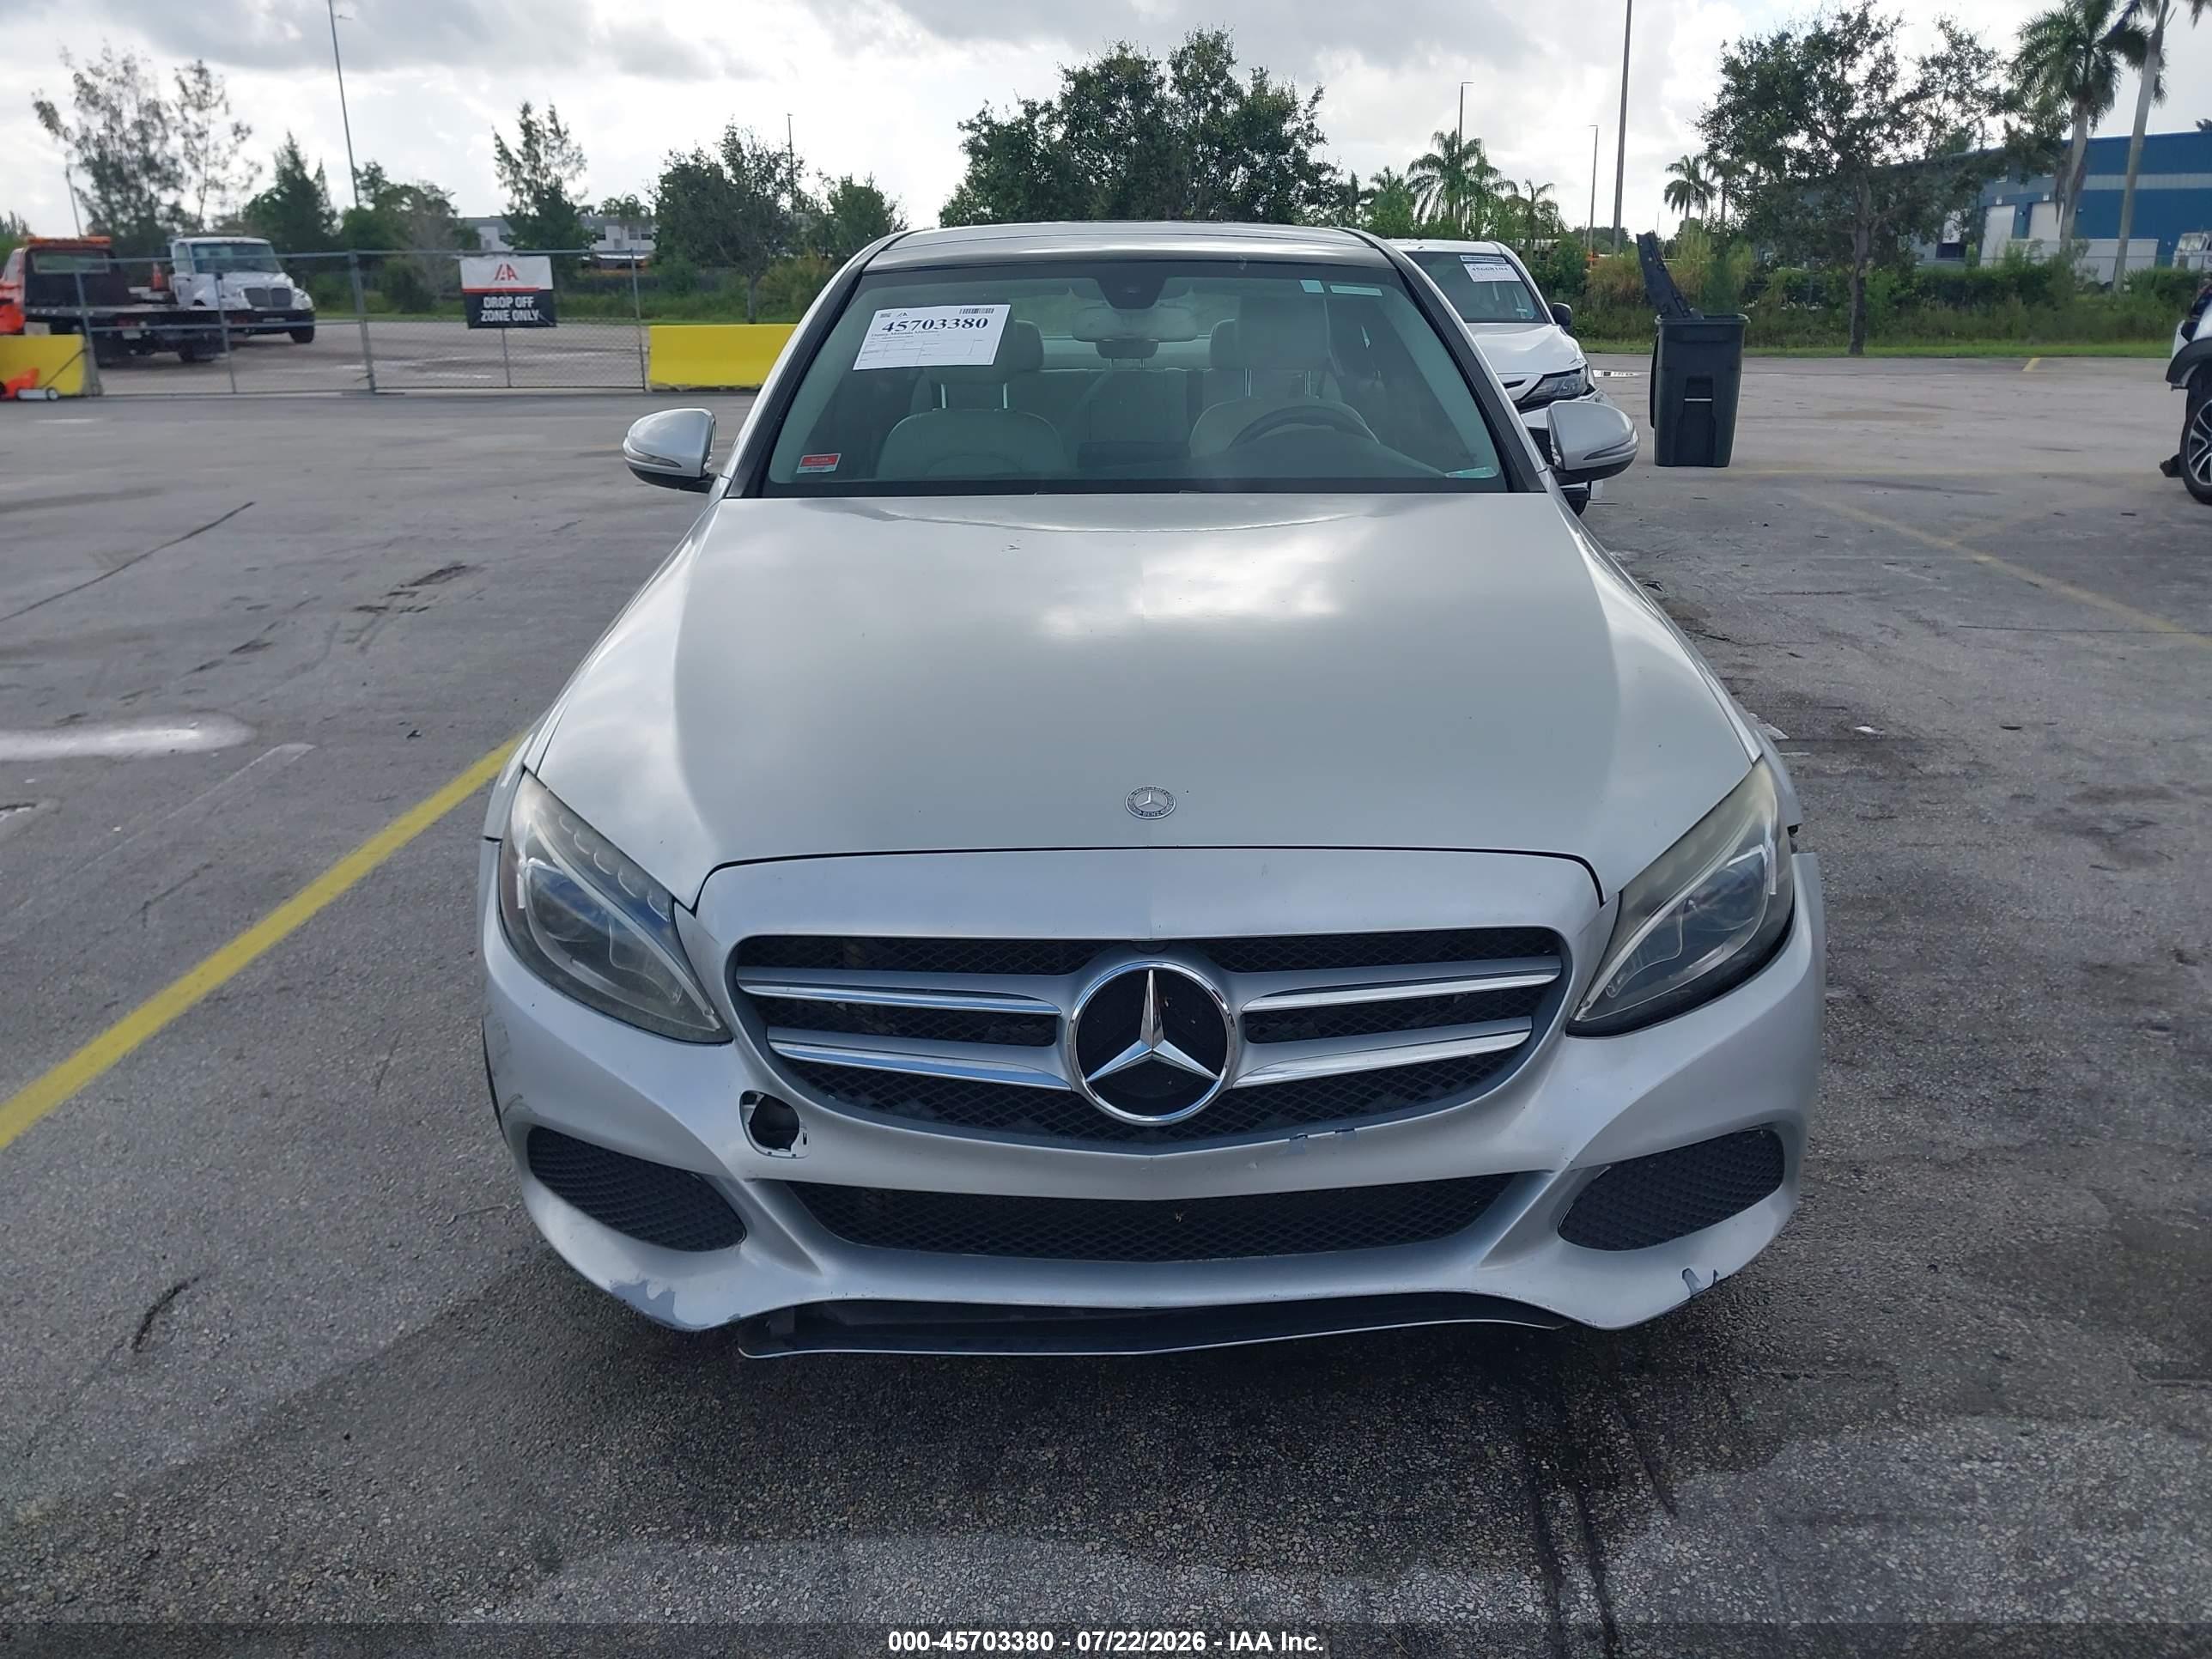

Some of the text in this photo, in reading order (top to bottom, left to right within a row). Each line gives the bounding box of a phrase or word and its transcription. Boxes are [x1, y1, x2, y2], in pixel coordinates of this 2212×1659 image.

[483, 296, 534, 308] DROP OFF
[481, 309, 539, 322] ZONE ONLY
[881, 317, 988, 332] 45703380
